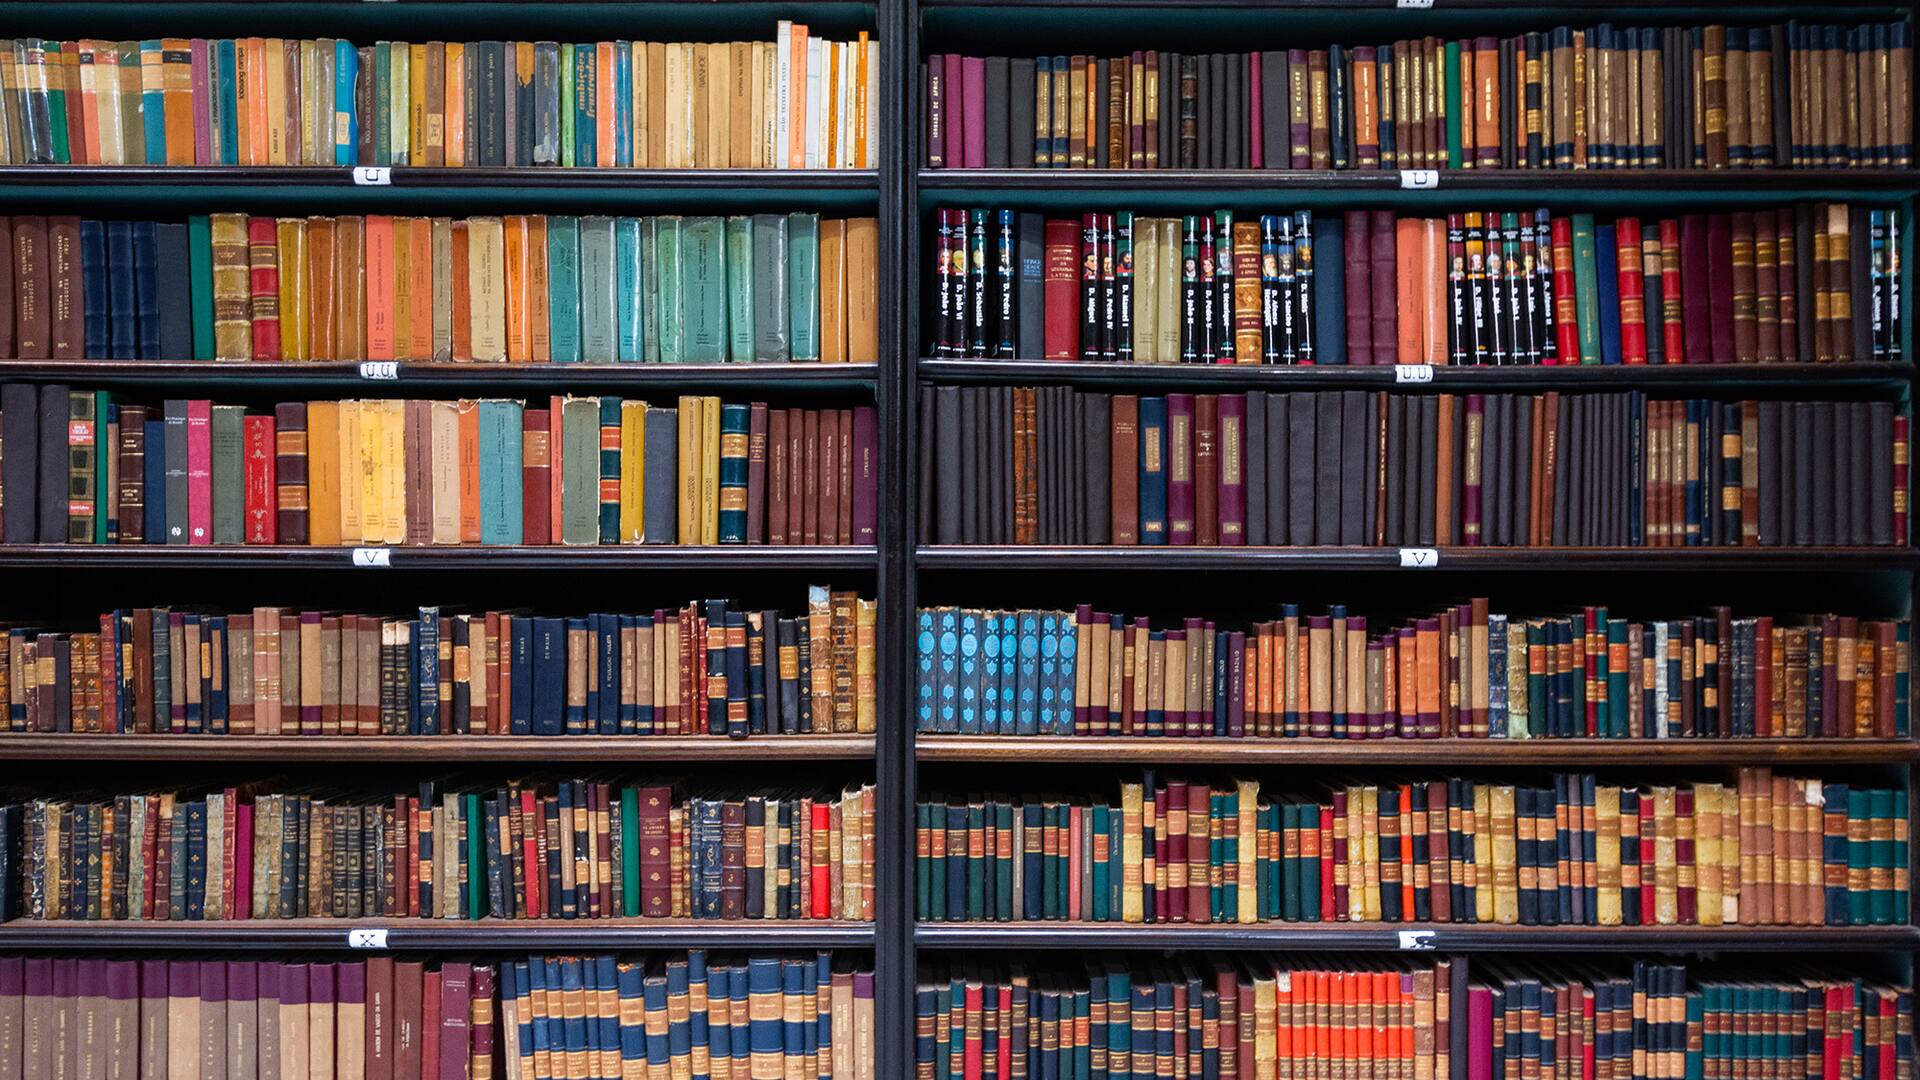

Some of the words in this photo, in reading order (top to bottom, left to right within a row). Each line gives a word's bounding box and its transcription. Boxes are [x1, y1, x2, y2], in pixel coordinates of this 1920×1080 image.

[577, 52, 587, 110] ambições
[586, 52, 595, 118] frustradas
[932, 101, 939, 109] DE
[365, 169, 380, 181] U
[1413, 172, 1428, 184] U
[1003, 283, 1010, 291] D.
[1087, 287, 1095, 296] D.
[1122, 284, 1129, 293] D.
[1222, 283, 1230, 291] D.
[1301, 283, 1308, 292] D.
[1106, 288, 1113, 297] D.
[1187, 289, 1194, 298] D.
[1206, 290, 1212, 298] D.
[1285, 290, 1292, 298] D.
[955, 294, 963, 310] João
[1087, 298, 1095, 323] Miguel
[1222, 293, 1230, 327] Henrique
[1264, 289, 1272, 327] Henriques
[955, 311, 963, 319] VI
[1106, 321, 1113, 330] IV
[1402, 367, 1430, 379] U.U.
[364, 551, 379, 563] V
[1412, 552, 1427, 565] V
[360, 935, 375, 946] X
